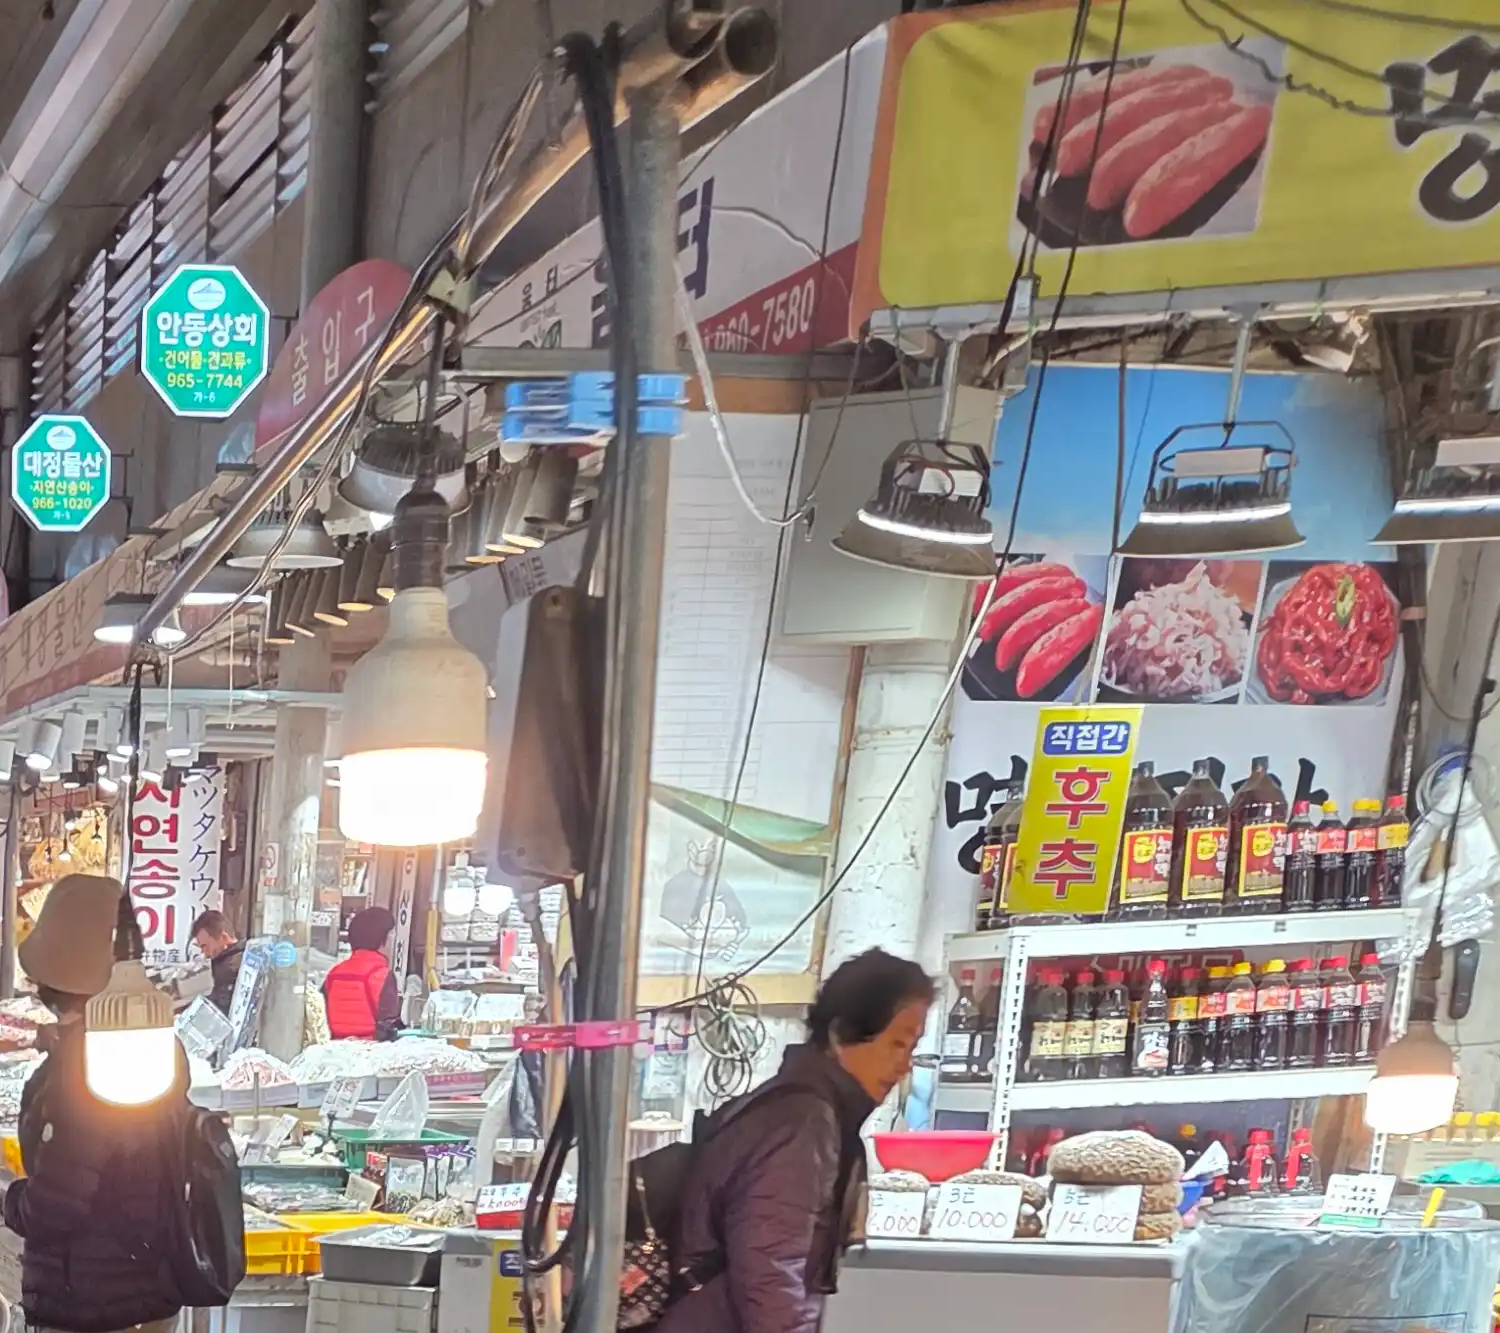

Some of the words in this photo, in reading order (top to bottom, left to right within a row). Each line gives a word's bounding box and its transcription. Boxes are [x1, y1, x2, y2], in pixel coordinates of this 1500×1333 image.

[156, 312, 257, 348] 안동상회
[291, 285, 376, 407] 출입구
[167, 373, 243, 389] 965-7744
[23, 450, 104, 479] 대정물산
[32, 497, 92, 510] 966-1020
[1049, 722, 1129, 754] 직접간
[1033, 766, 1111, 899] 후추
